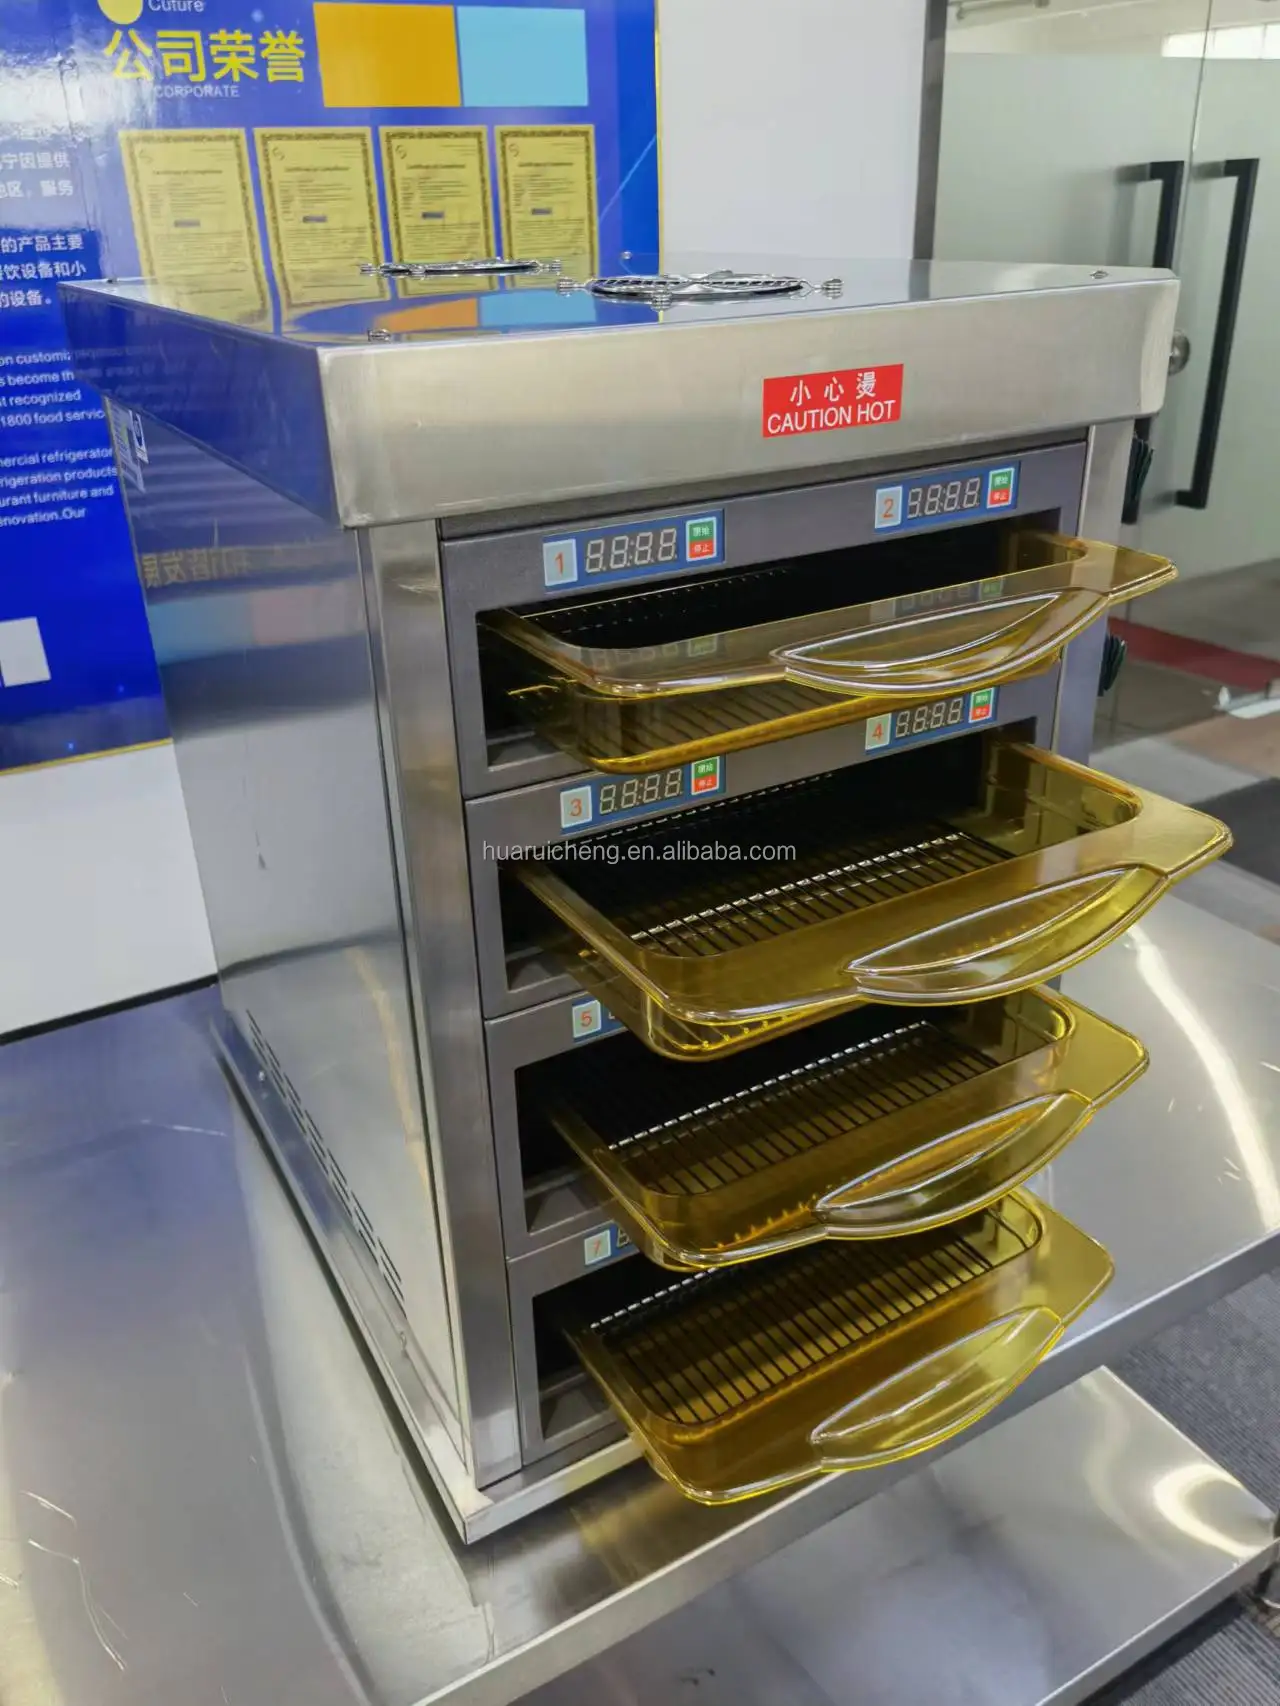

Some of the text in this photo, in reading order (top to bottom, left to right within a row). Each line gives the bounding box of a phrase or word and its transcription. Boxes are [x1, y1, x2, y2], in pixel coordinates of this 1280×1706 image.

[105, 28, 305, 83] 公司荣誉
[154, 84, 240, 98] CORPORATE
[0, 260, 87, 281] 饮设备和小
[7, 371, 60, 386] become
[9, 388, 82, 406] recognized
[33, 409, 63, 424] food
[767, 399, 896, 434] CAUTION HOT
[64, 466, 117, 483] products
[33, 488, 88, 503] furniture
[90, 484, 114, 498] and
[883, 497, 894, 518] 2
[554, 552, 564, 576] 1
[872, 723, 884, 743] 4
[569, 798, 583, 817] 3
[581, 1010, 593, 1027] 5
[592, 1238, 602, 1257] 7
